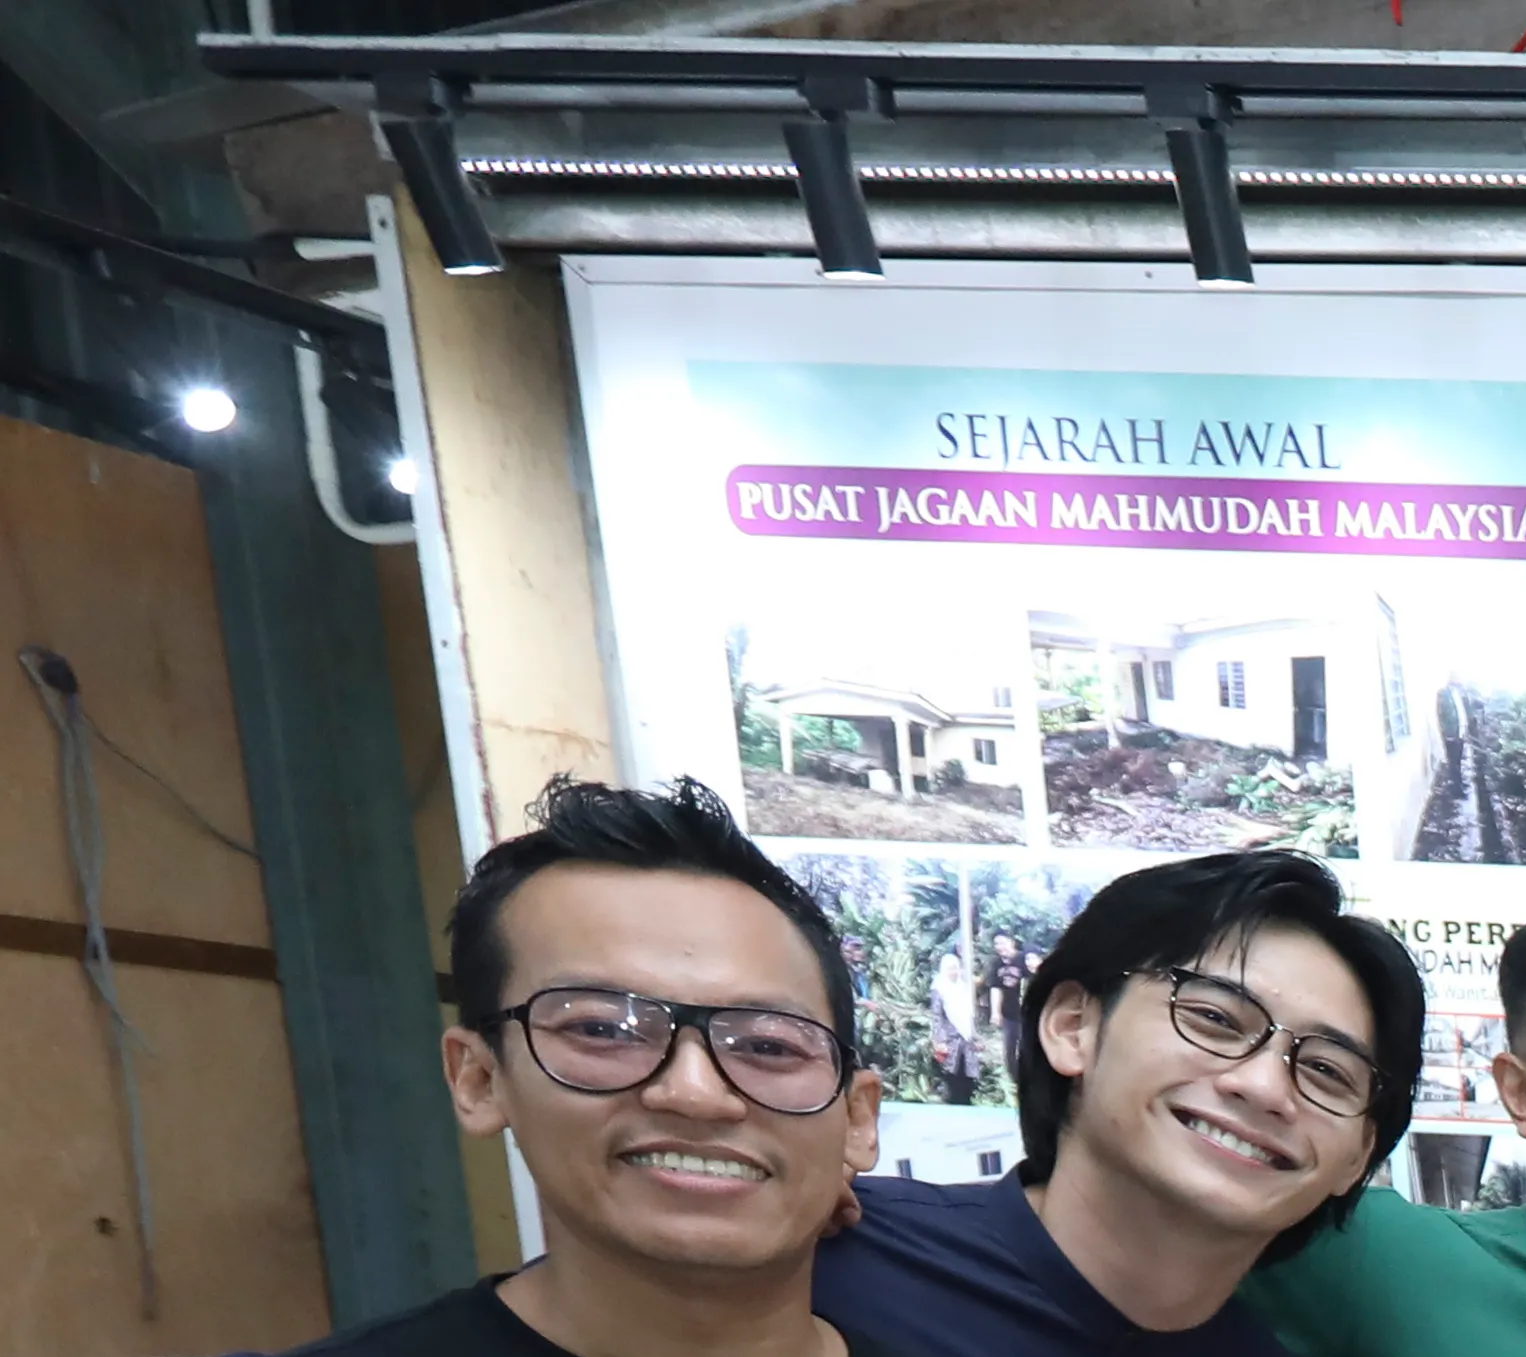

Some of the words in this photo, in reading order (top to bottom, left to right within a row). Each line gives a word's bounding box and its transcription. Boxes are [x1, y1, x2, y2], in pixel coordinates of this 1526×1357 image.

[935, 411, 1166, 468] SEJARAH
[1187, 420, 1341, 470] AWAL
[736, 482, 865, 523] PUSAT
[874, 486, 1038, 533] JAGAAN
[1050, 490, 1323, 537] MAHMUDAH
[1442, 920, 1526, 946] PER
[1416, 948, 1473, 975] DAH
